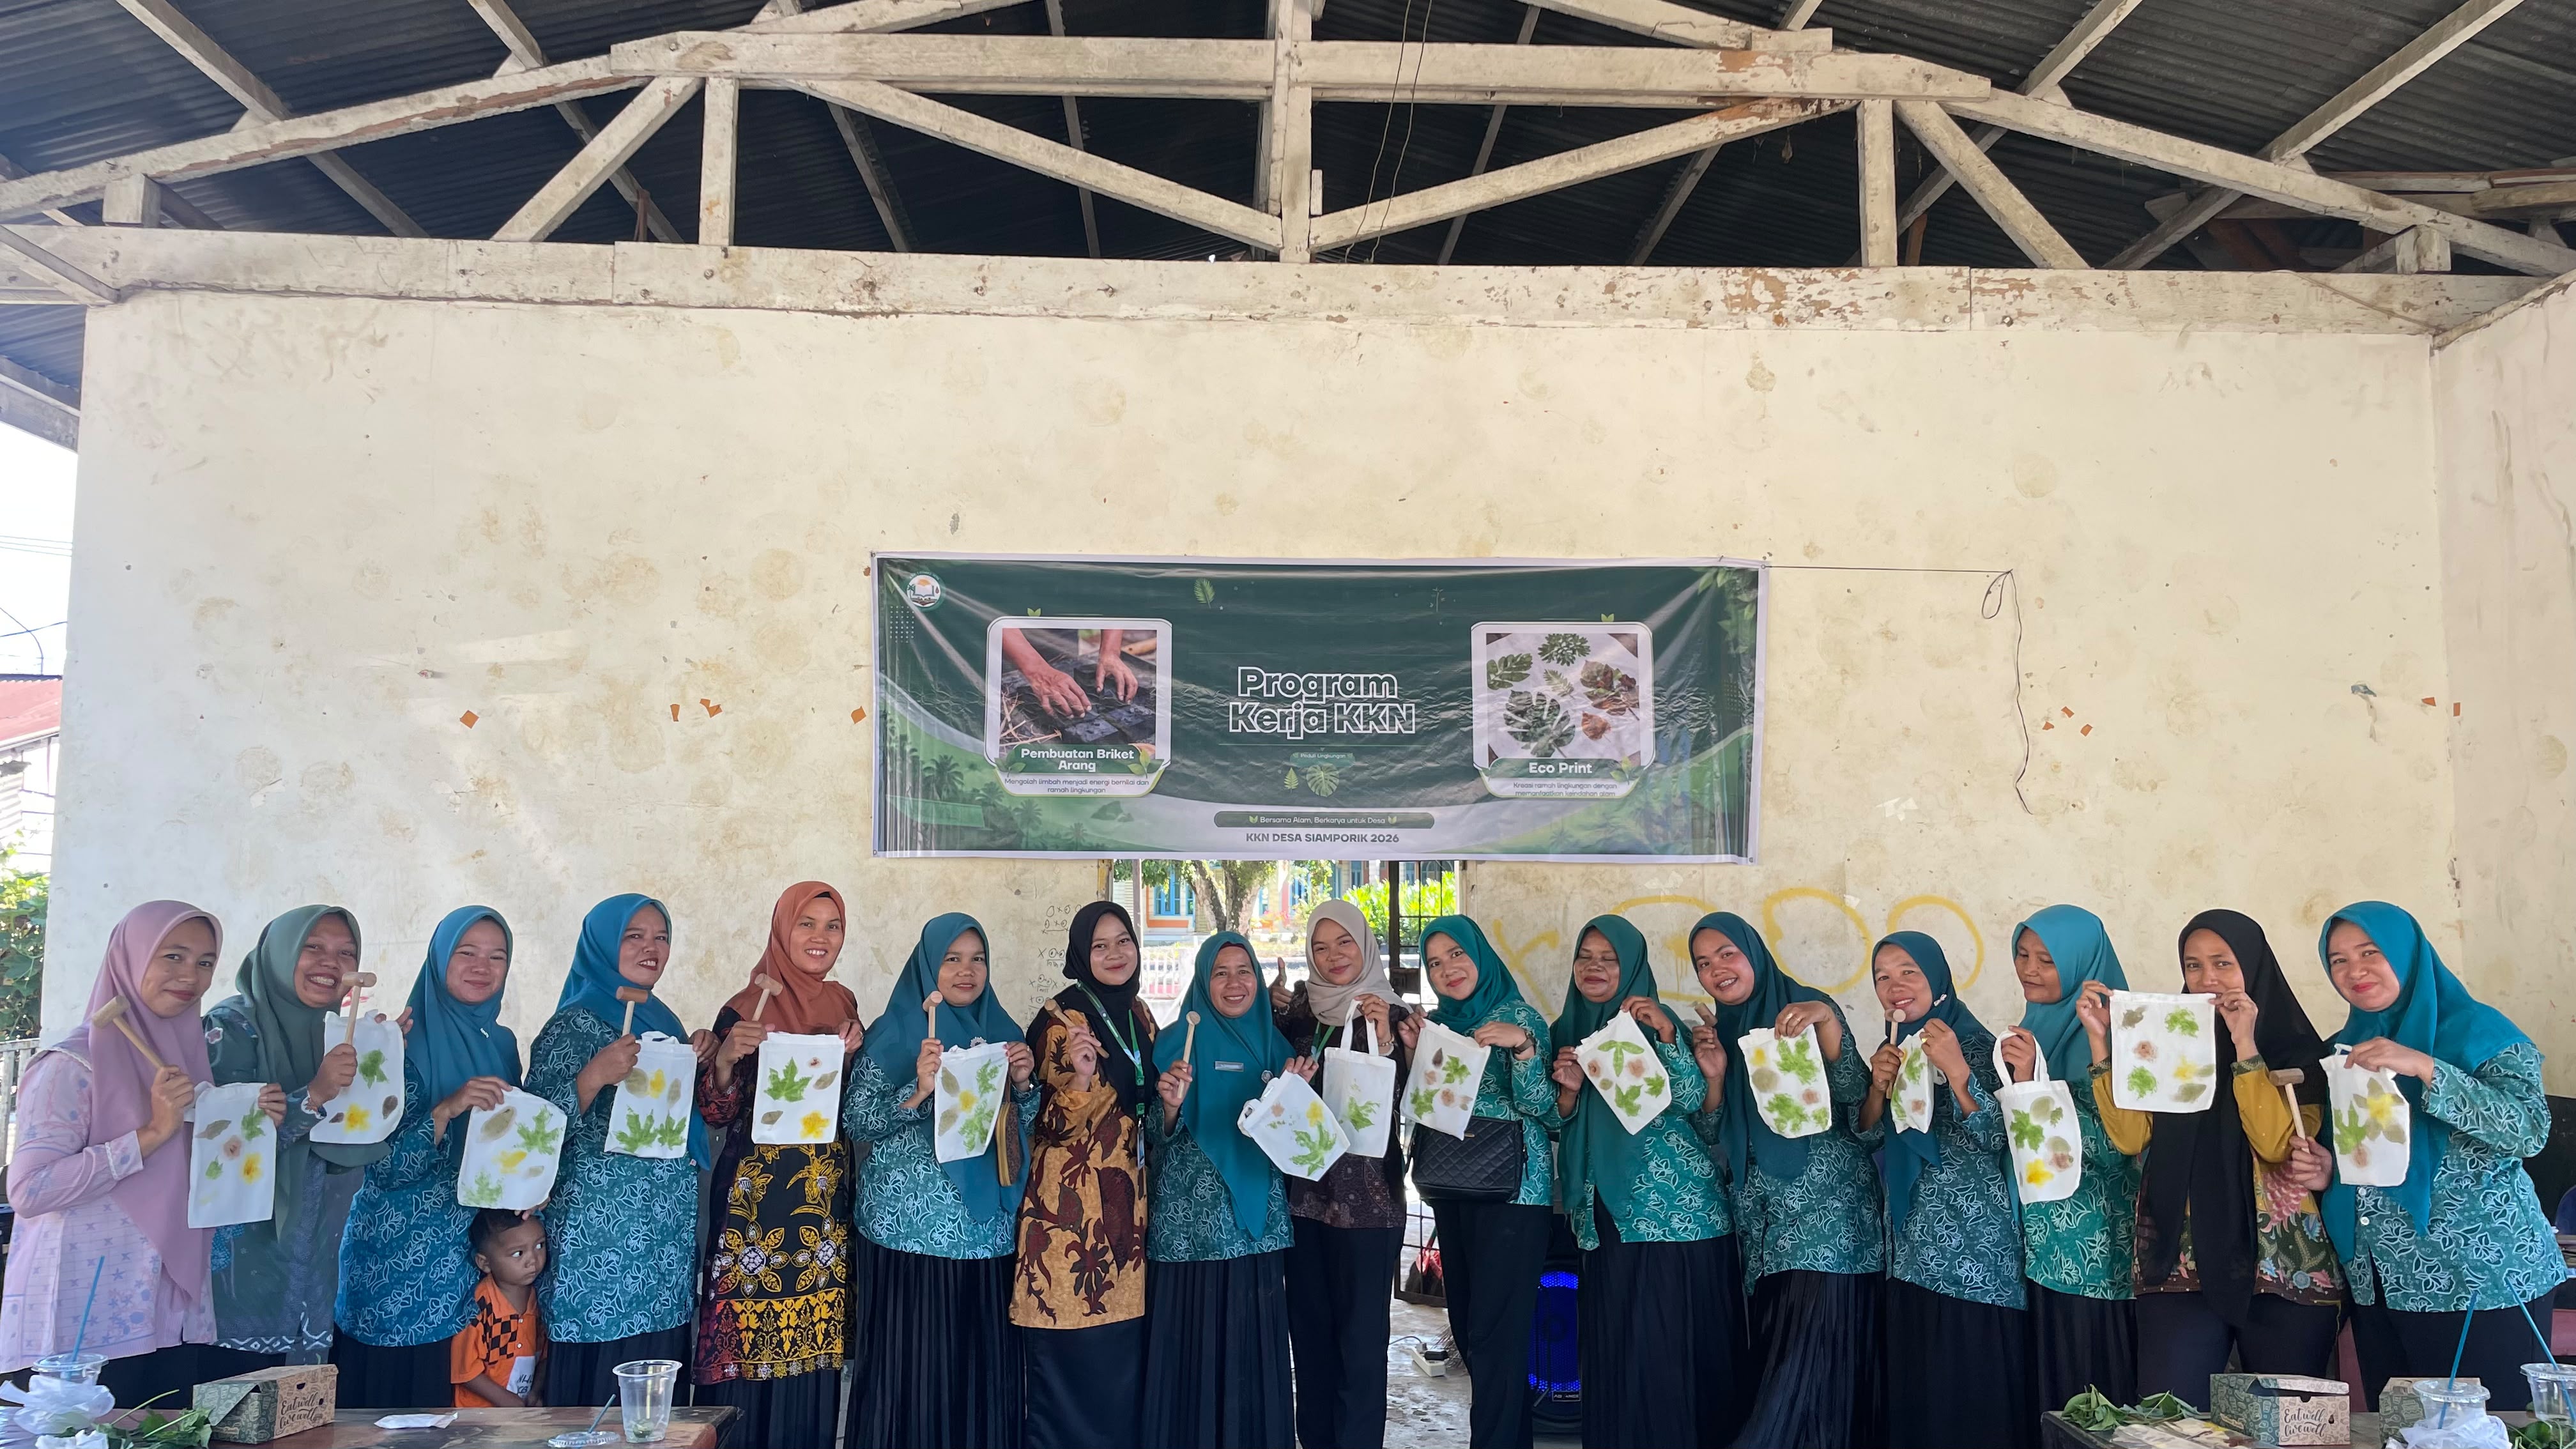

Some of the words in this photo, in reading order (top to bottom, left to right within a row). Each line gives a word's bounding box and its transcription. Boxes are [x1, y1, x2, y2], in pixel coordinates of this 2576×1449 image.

[1238, 666, 1398, 704] Program
[1229, 701, 1327, 740] Kerja
[1334, 703, 1416, 734] KKN
[1021, 749, 1094, 758] Pembuatan
[1097, 749, 1134, 759] Briket
[1058, 760, 1096, 772] Arang
[1529, 762, 1555, 774] Eco
[1559, 762, 1593, 774] Print
[1292, 816, 1313, 825] Alam,
[1314, 816, 1346, 825] Berkarya
[1246, 833, 1269, 842] KKN
[1273, 833, 1302, 842] DESA
[1305, 833, 1368, 843] SIAMPORIK
[1370, 834, 1399, 843] 2026
[2284, 1408, 2303, 1423] Eat
[2303, 1409, 2326, 1422] well
[2285, 1424, 2303, 1437] live
[2303, 1422, 2326, 1438] well
